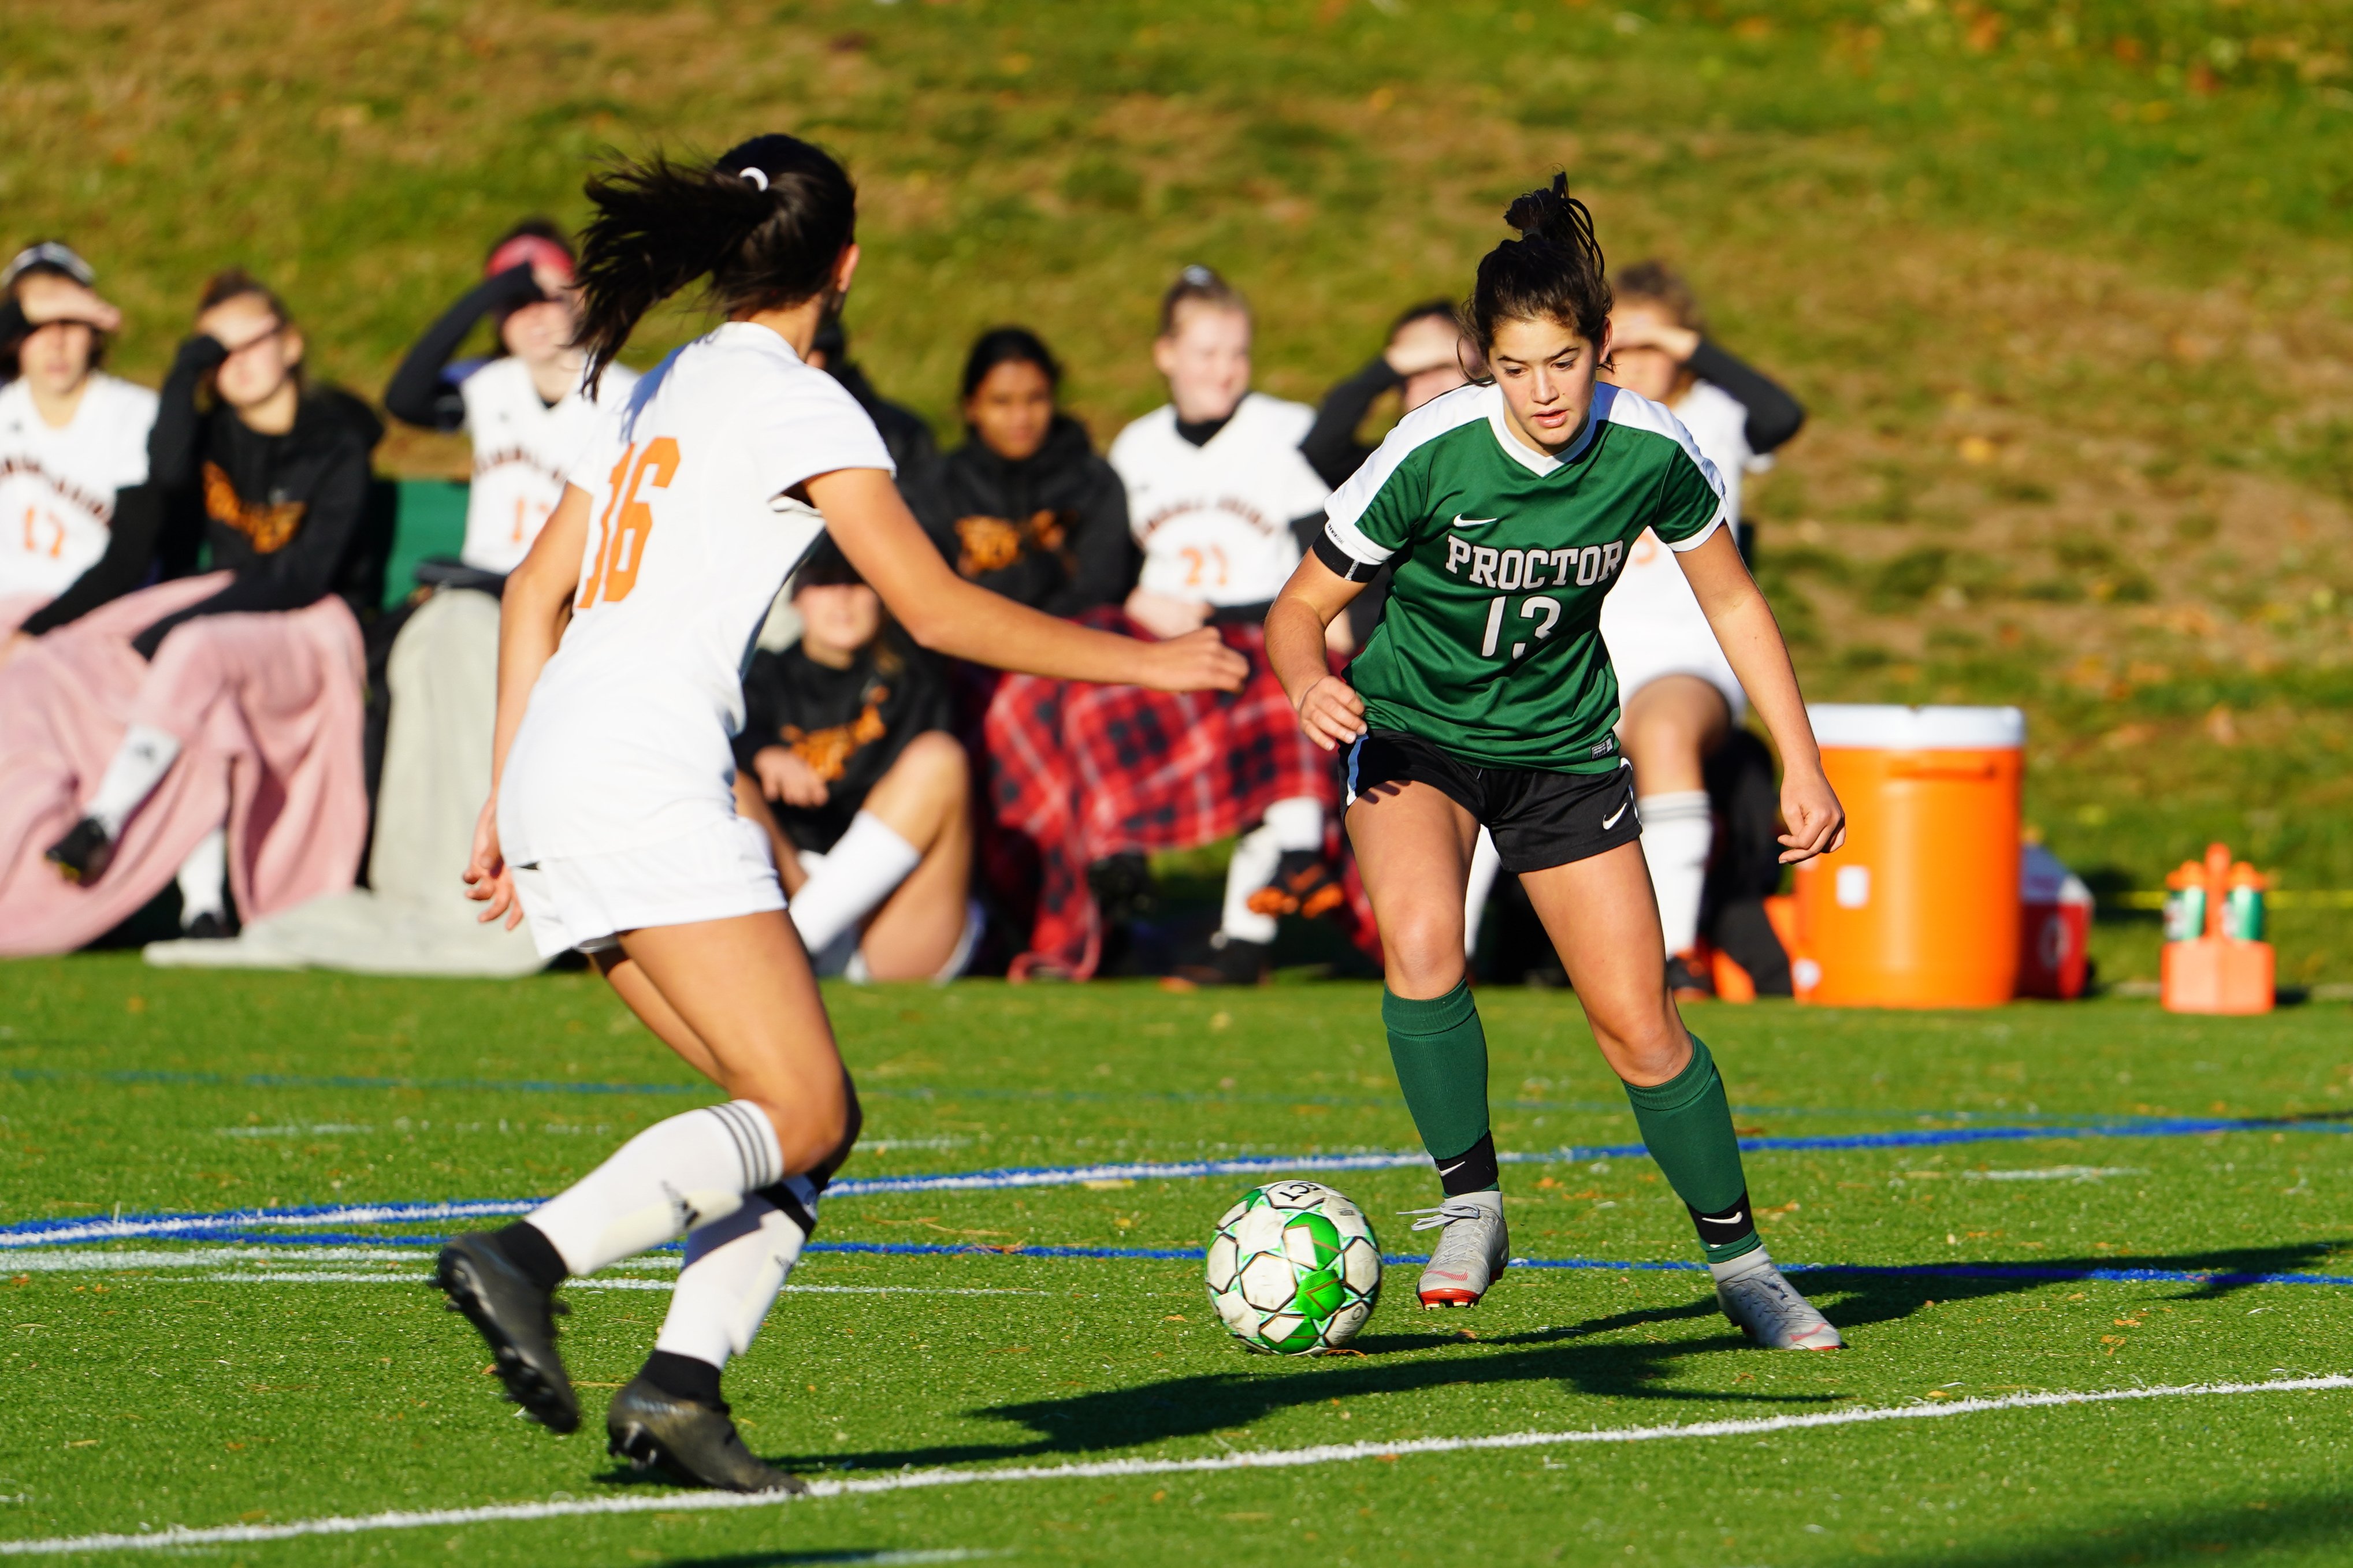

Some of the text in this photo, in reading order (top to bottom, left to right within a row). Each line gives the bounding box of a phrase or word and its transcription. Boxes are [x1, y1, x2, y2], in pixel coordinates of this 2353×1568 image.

[575, 437, 681, 609] 16
[1445, 534, 1623, 590] PROCTOR
[1481, 595, 1561, 660] 13
